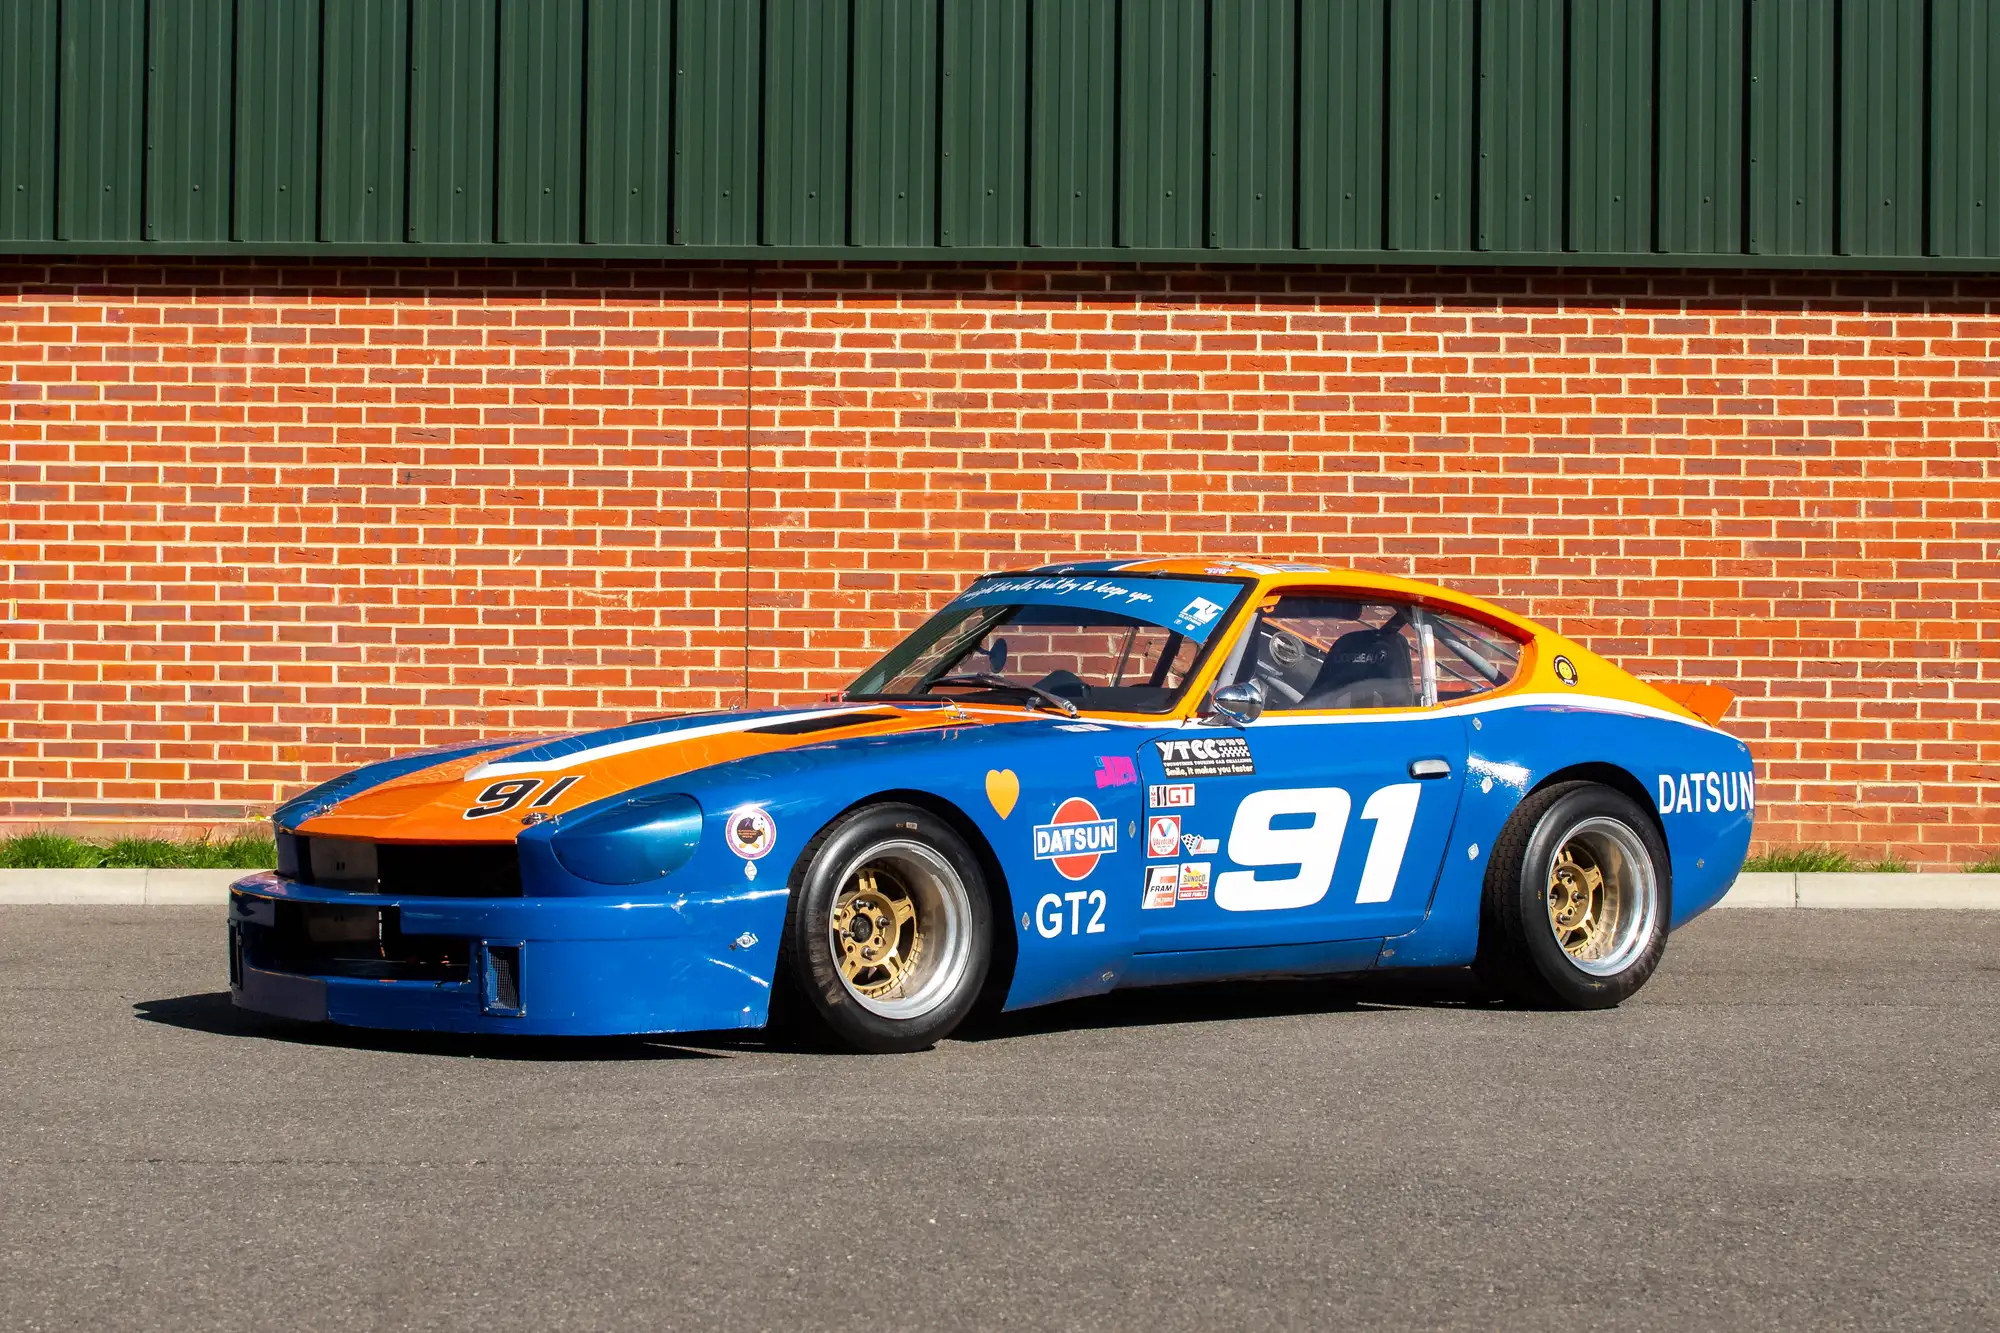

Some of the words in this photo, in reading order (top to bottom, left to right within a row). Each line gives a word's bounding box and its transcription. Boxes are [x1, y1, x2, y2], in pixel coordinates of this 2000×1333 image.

[1155, 739, 1221, 760] YTCC
[1166, 768, 1187, 777] Smile,
[1188, 766, 1193, 775] it
[1195, 766, 1217, 775] makes
[1217, 766, 1231, 776] you
[1231, 764, 1253, 773] faster
[462, 775, 586, 820] 91
[1168, 786, 1193, 804] GT
[1658, 771, 1754, 814] DATSUN
[1037, 825, 1114, 854] DATSUN
[1214, 783, 1422, 912] 91
[1183, 874, 1206, 882] SUNOCO
[1036, 889, 1107, 939] GT2
